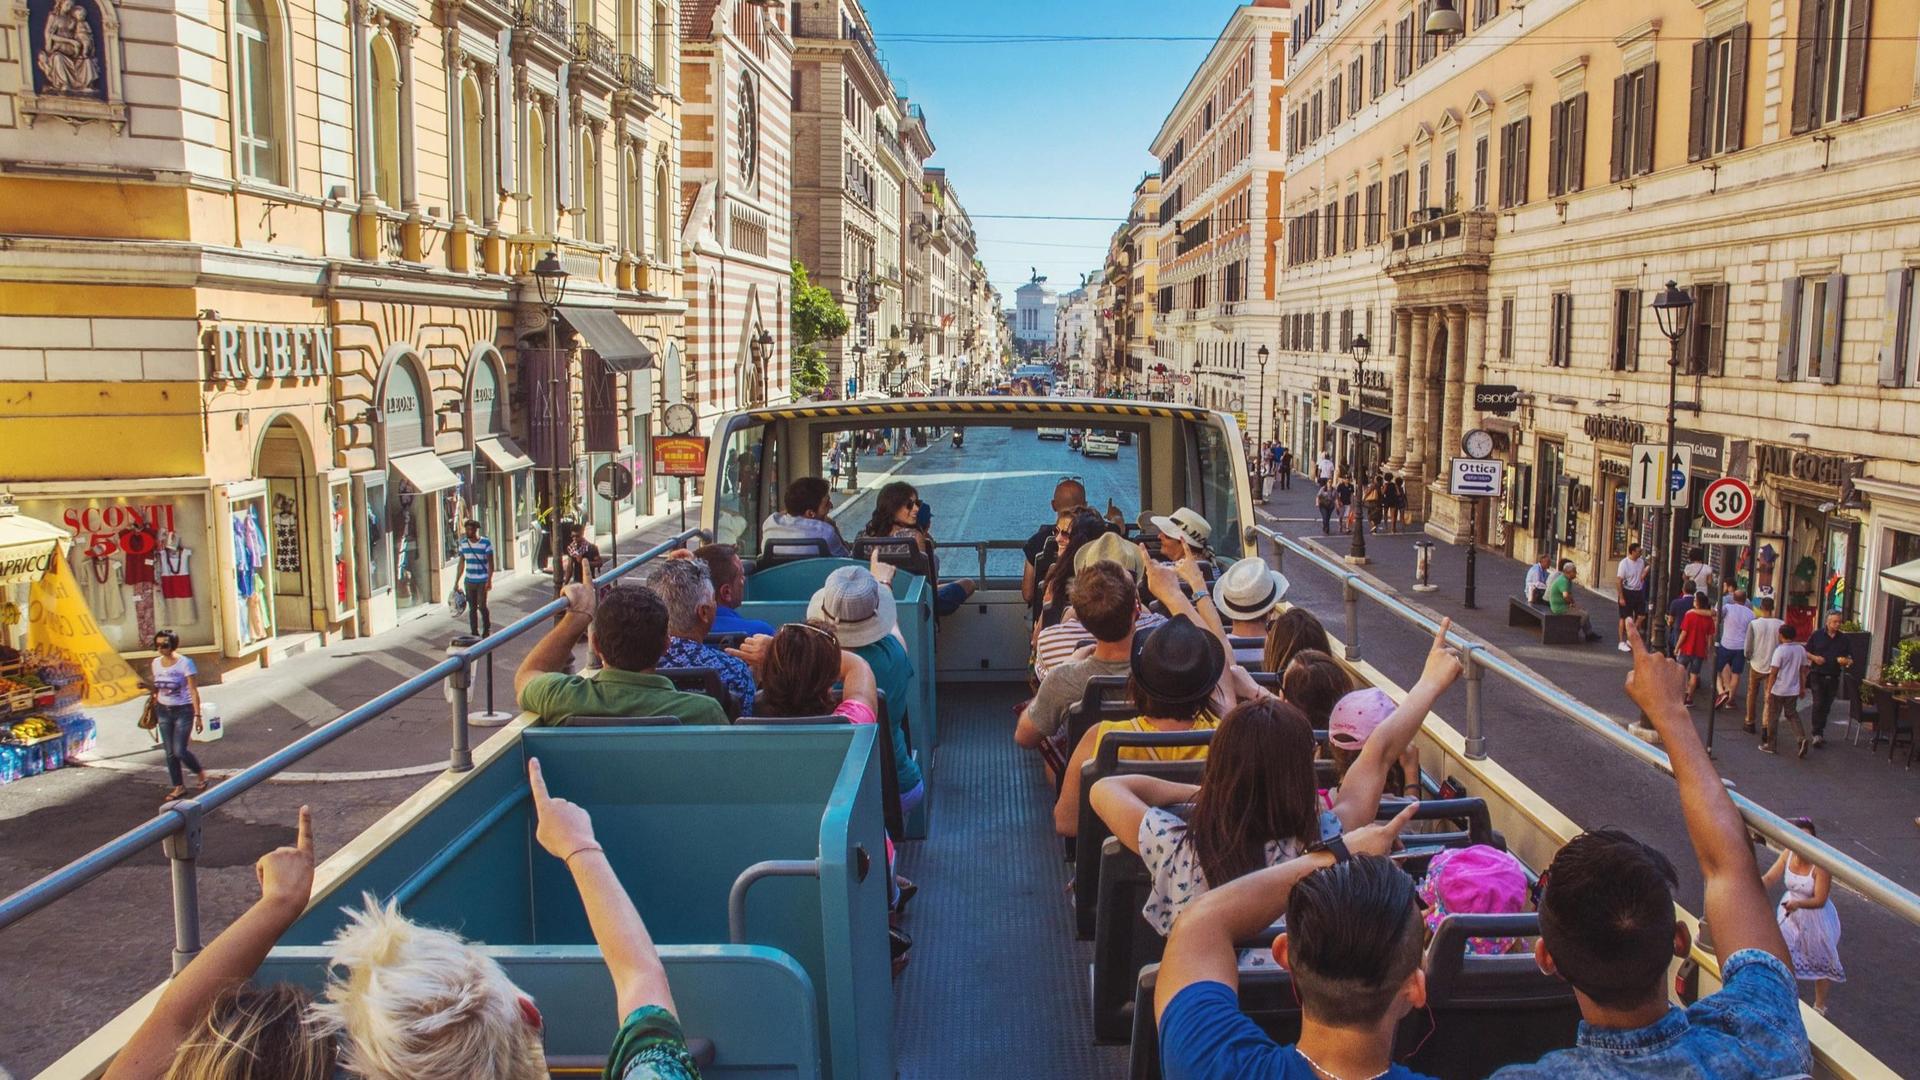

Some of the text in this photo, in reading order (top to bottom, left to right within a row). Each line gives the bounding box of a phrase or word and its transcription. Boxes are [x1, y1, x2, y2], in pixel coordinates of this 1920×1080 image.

[217, 322, 333, 379] RUBEN
[1460, 463, 1497, 474] Ottica
[1791, 452, 1843, 487] GOGH
[1714, 491, 1743, 514] 30
[63, 503, 177, 537] SCONTI
[84, 532, 156, 558] 50
